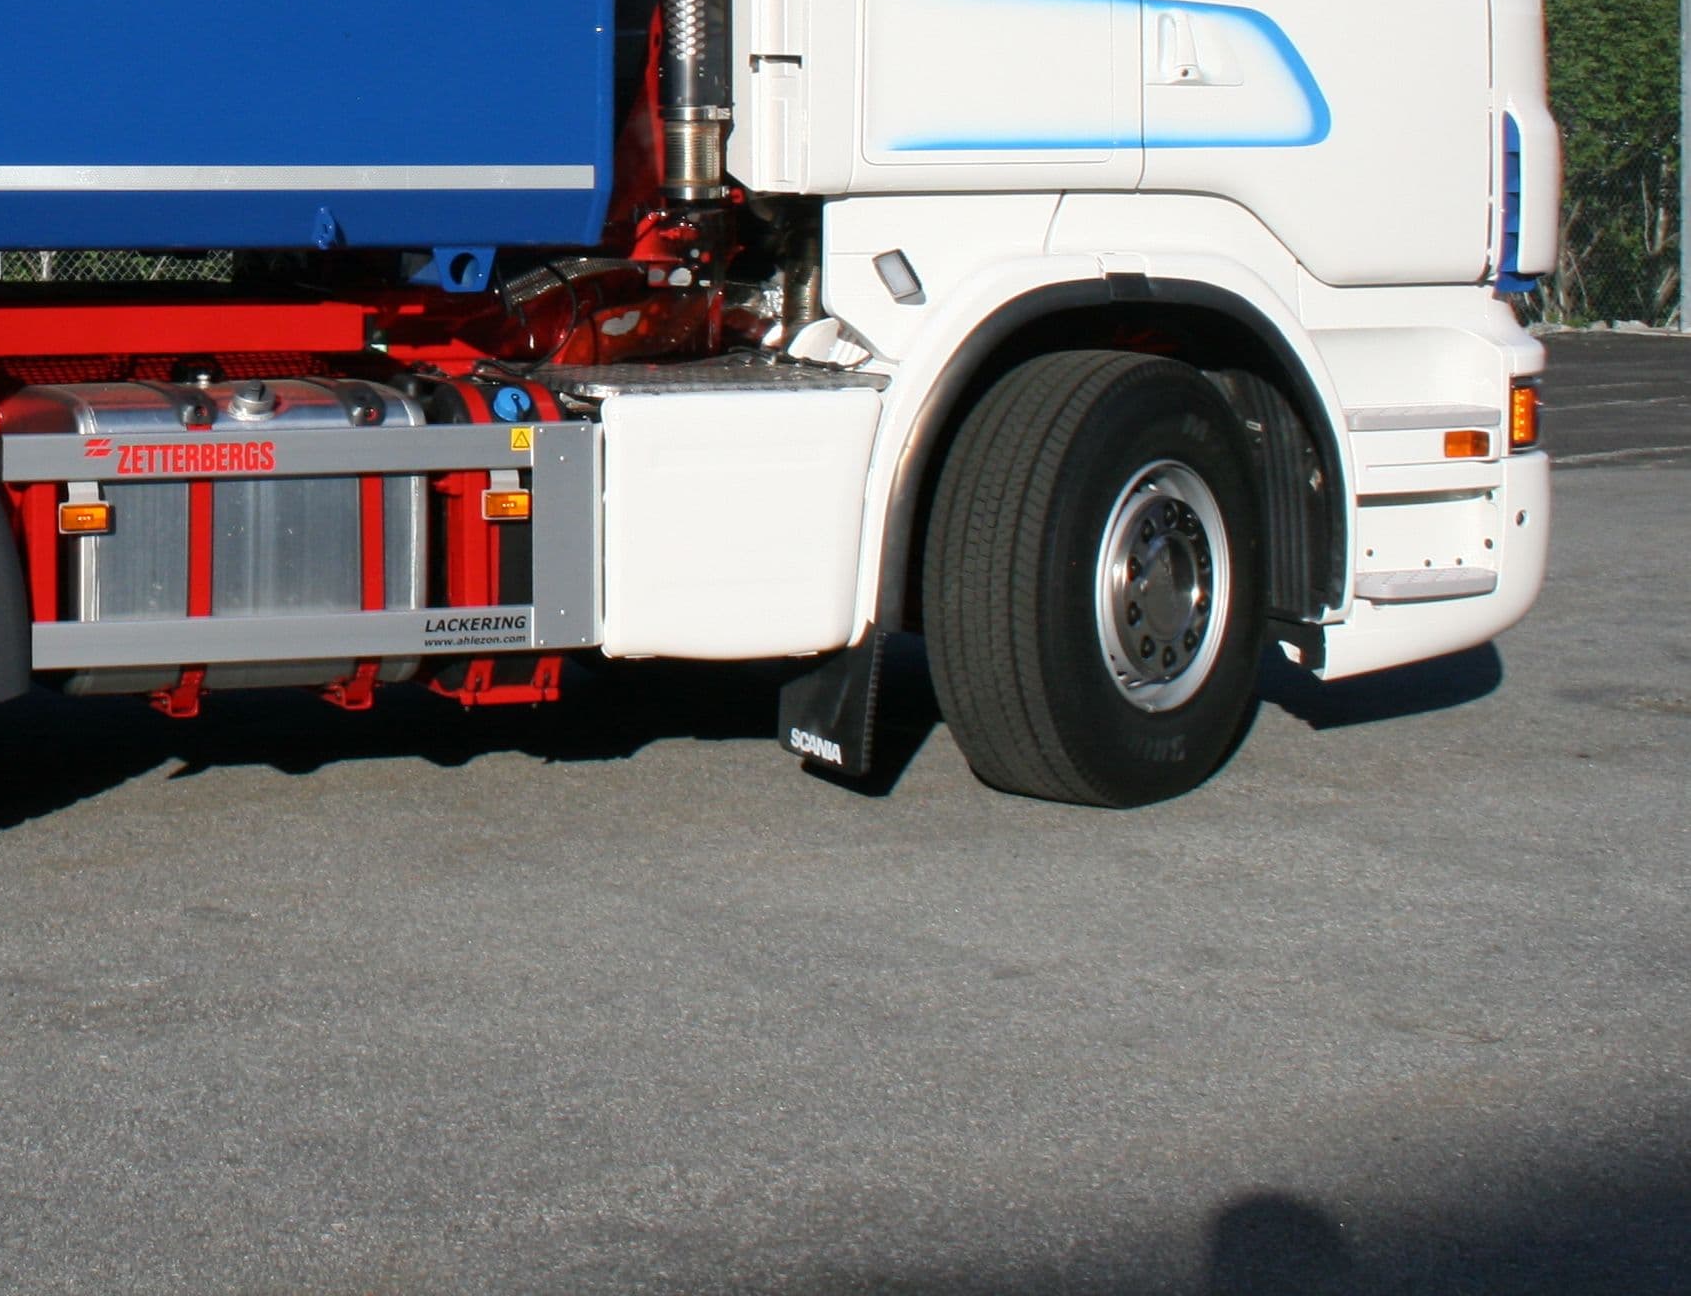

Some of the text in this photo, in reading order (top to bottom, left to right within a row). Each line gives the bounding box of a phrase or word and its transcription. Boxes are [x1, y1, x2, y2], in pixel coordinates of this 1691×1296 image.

[117, 441, 275, 474] ZETTERBERGS
[425, 615, 526, 632] LACKERING
[424, 635, 526, 646] www.ahlezon.com
[790, 727, 842, 765] SCANIA
